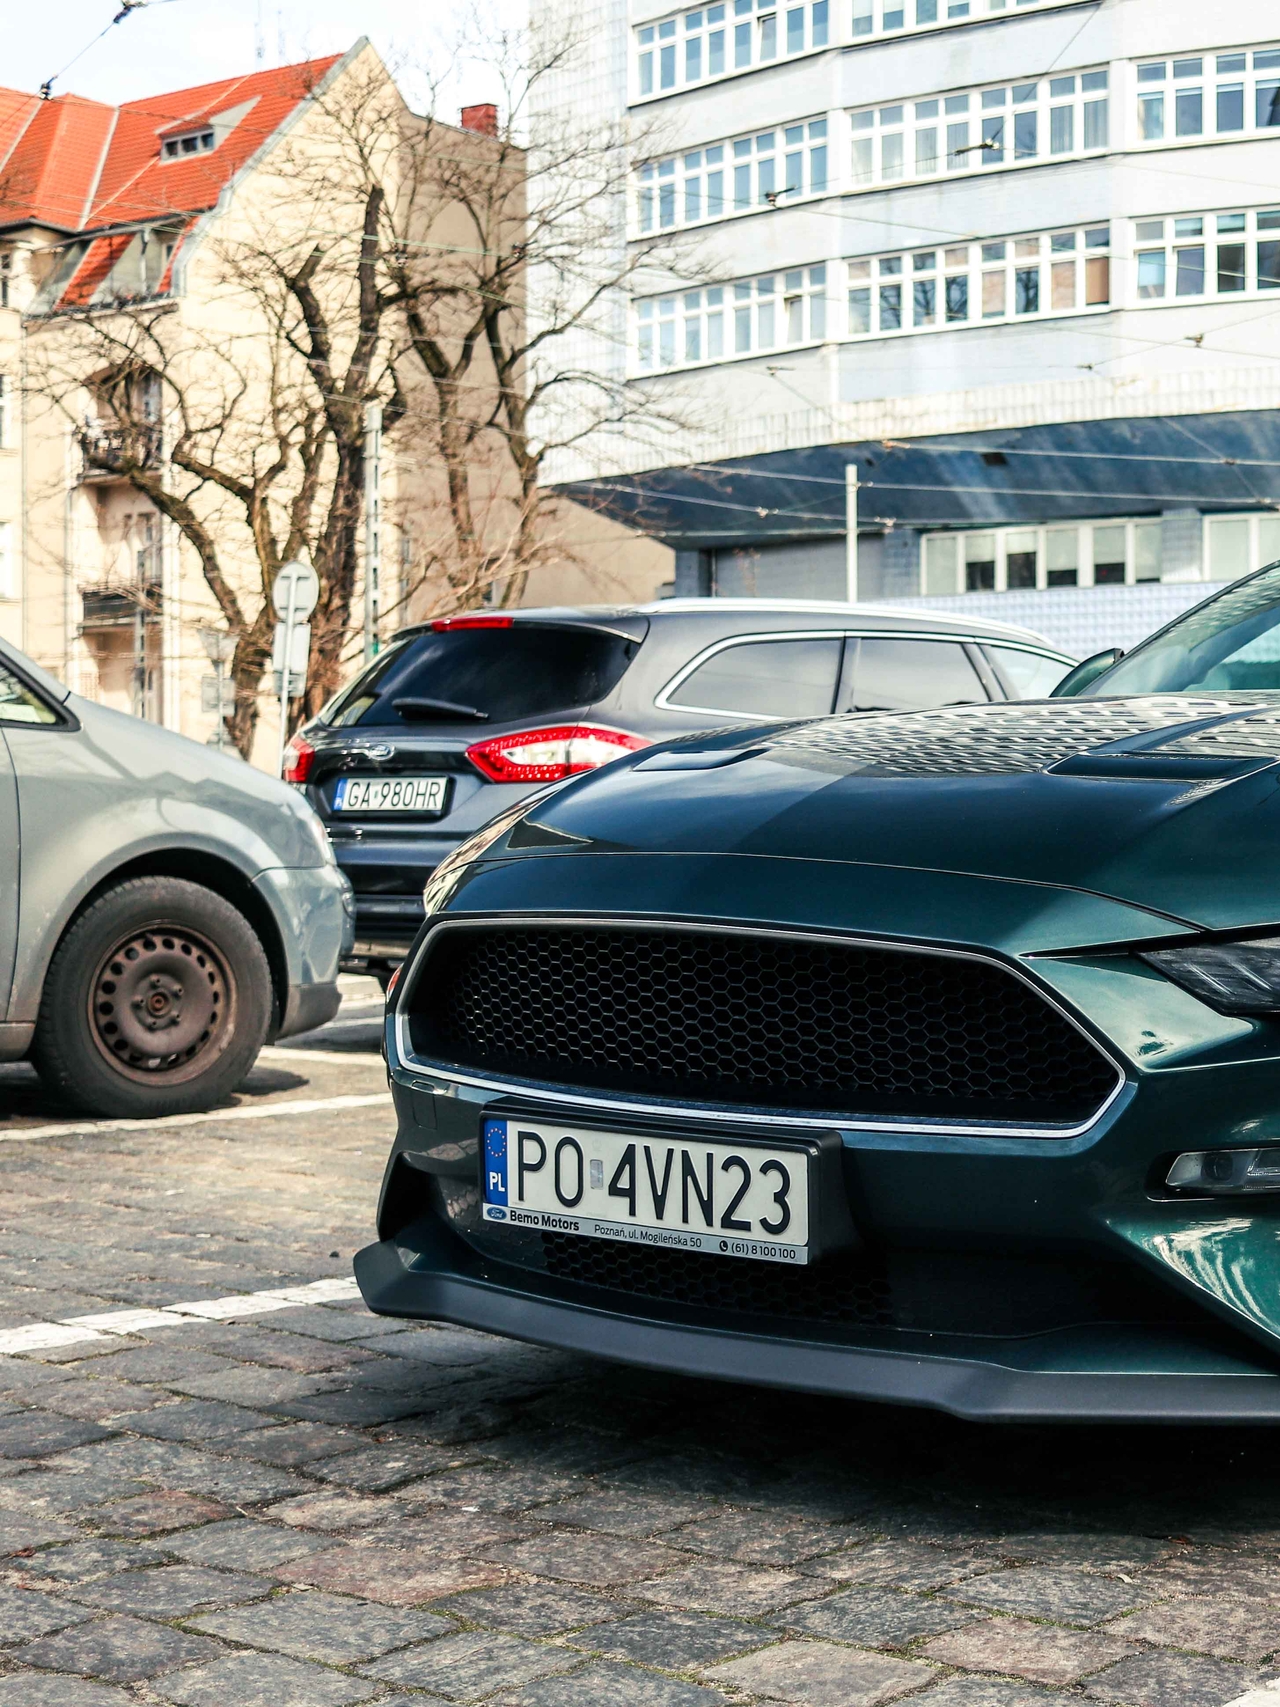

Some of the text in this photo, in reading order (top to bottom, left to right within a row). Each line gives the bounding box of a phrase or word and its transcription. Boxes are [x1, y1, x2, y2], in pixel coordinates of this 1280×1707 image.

[348, 782, 441, 808] GA 980HR
[489, 1171, 506, 1192] PL
[517, 1130, 791, 1235] PO 4VN23
[489, 1207, 505, 1219] Ford
[510, 1210, 580, 1232] Bemo Motors
[594, 1224, 702, 1248] Poznań, ul. Mogileńska 50
[731, 1242, 749, 1256] (61)
